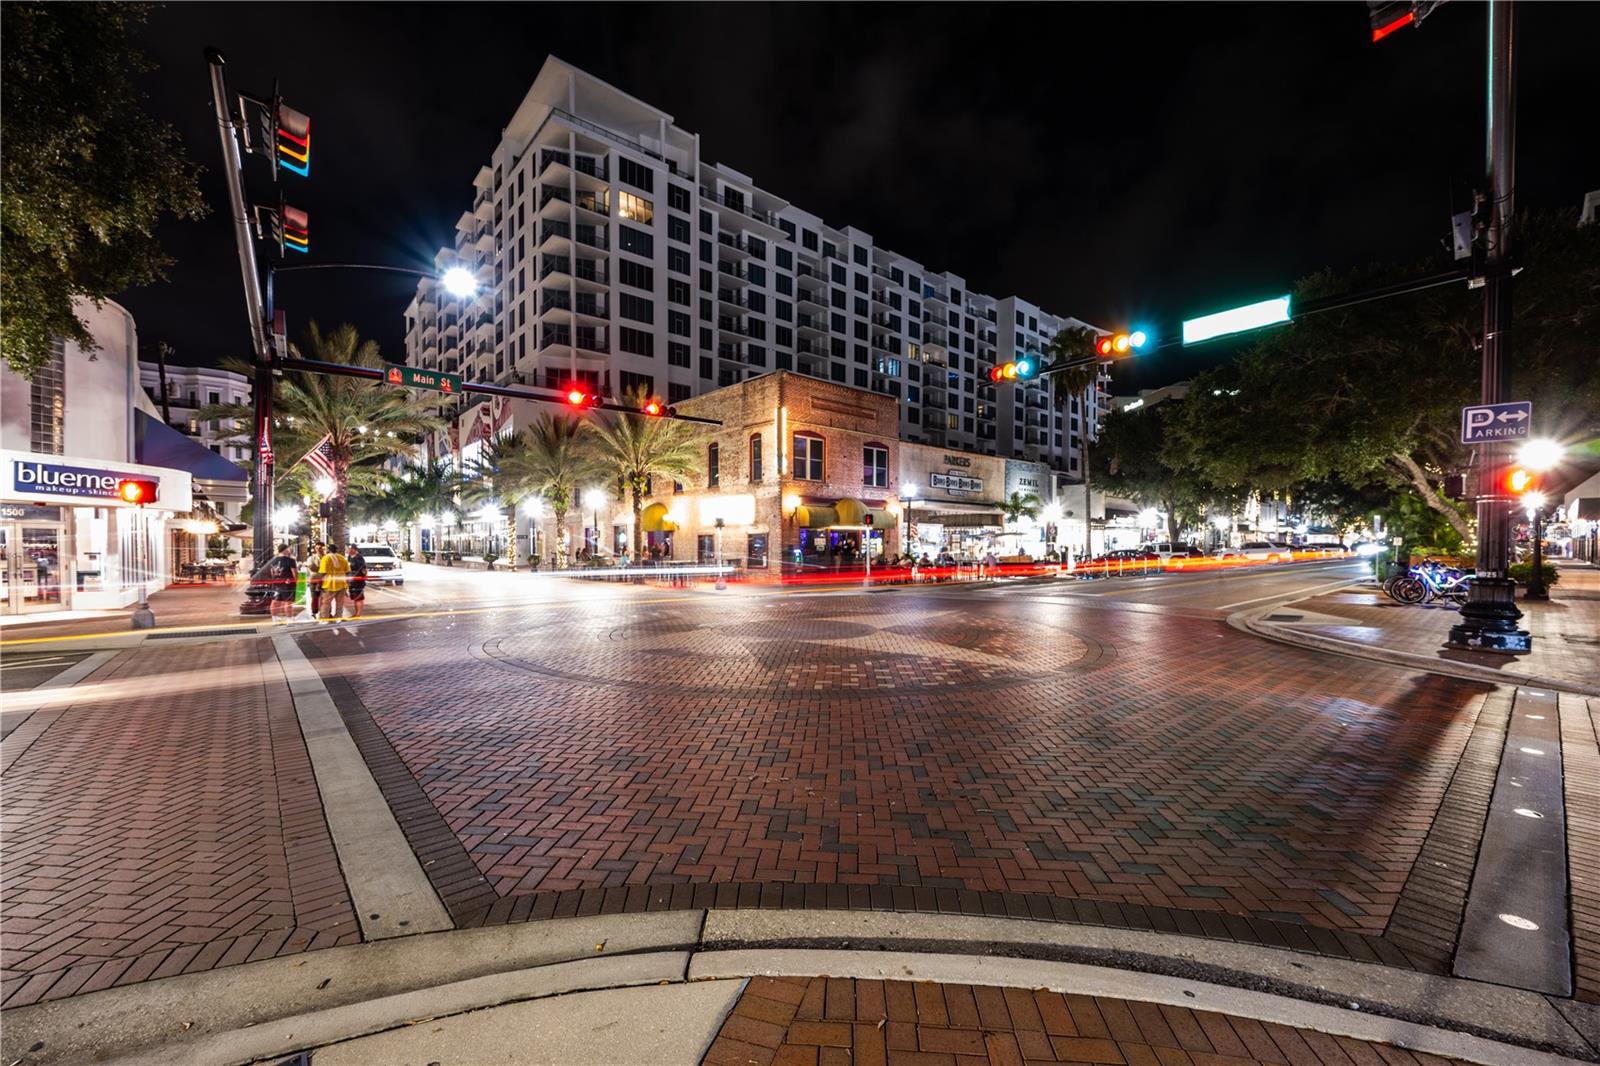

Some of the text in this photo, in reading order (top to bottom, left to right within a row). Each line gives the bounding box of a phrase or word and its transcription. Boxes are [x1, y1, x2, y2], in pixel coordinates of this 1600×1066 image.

[413, 373, 451, 387] Main St
[1466, 409, 1526, 439] PARKING
[18, 462, 124, 490] bluemer
[35, 485, 79, 494] makeup
[1, 508, 25, 517] 1500
